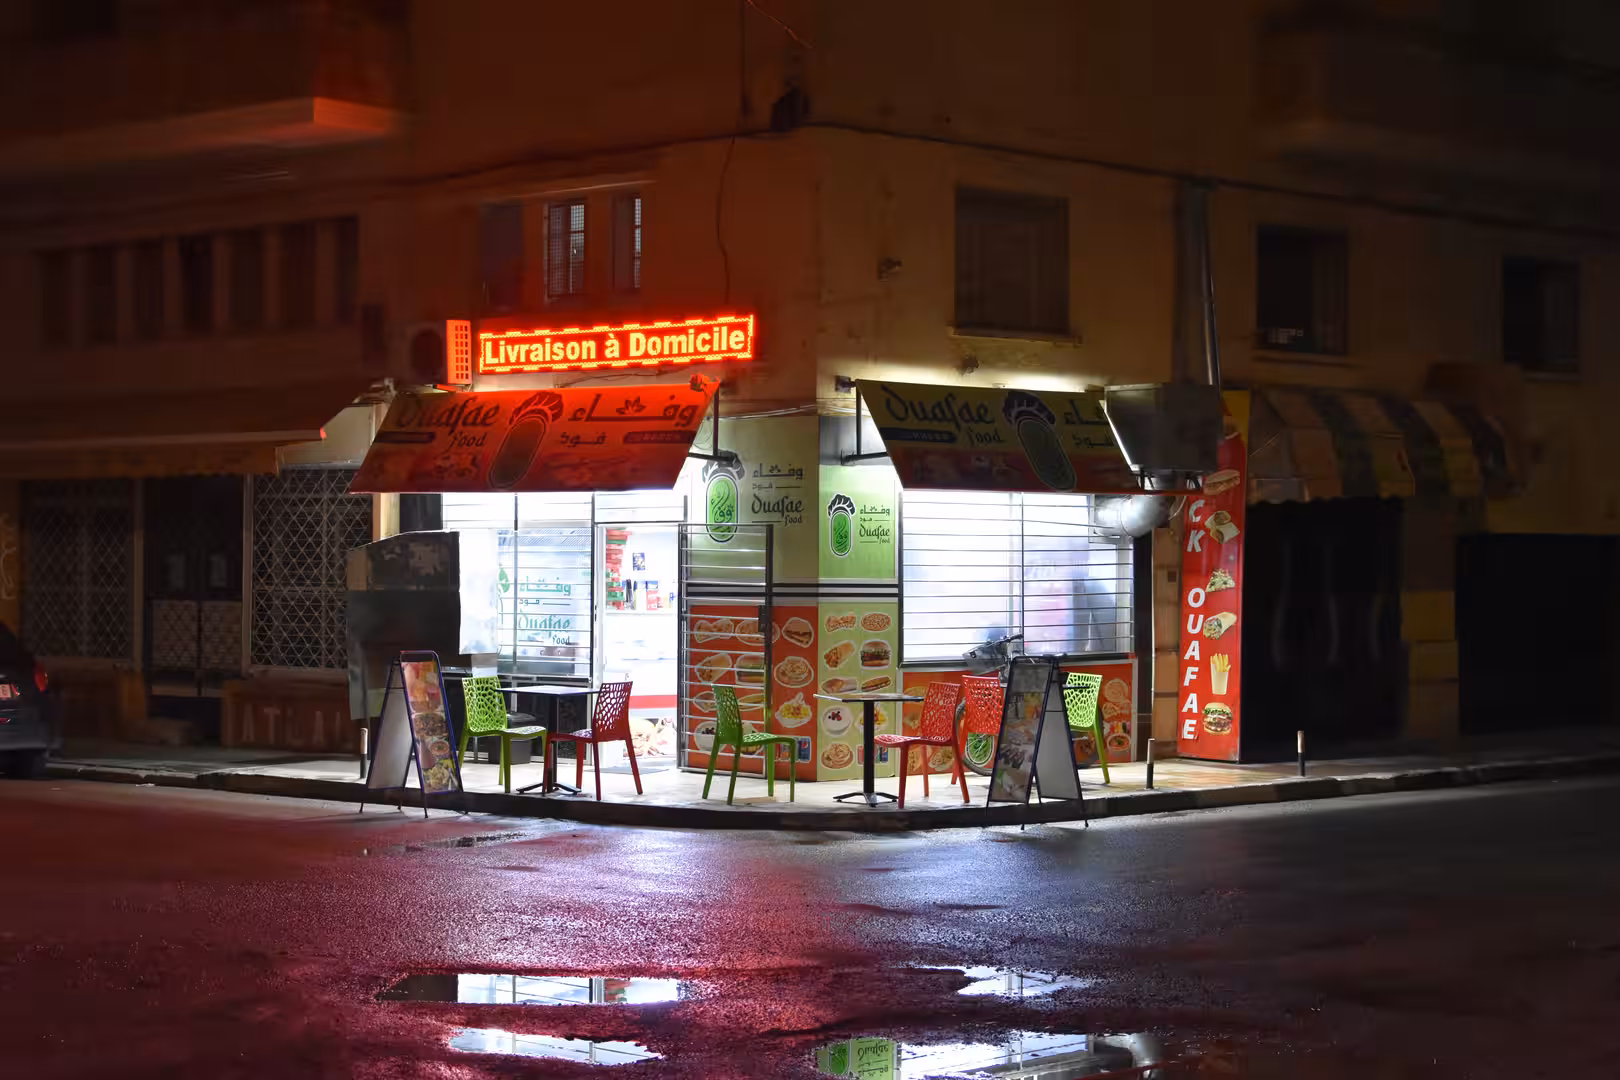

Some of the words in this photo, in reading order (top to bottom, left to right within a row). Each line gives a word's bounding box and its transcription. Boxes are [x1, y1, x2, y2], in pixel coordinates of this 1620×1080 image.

[485, 339, 596, 365] Livraison
[604, 333, 621, 359] à
[629, 326, 746, 358] Domicile
[1181, 587, 1206, 740] OUAFAE
